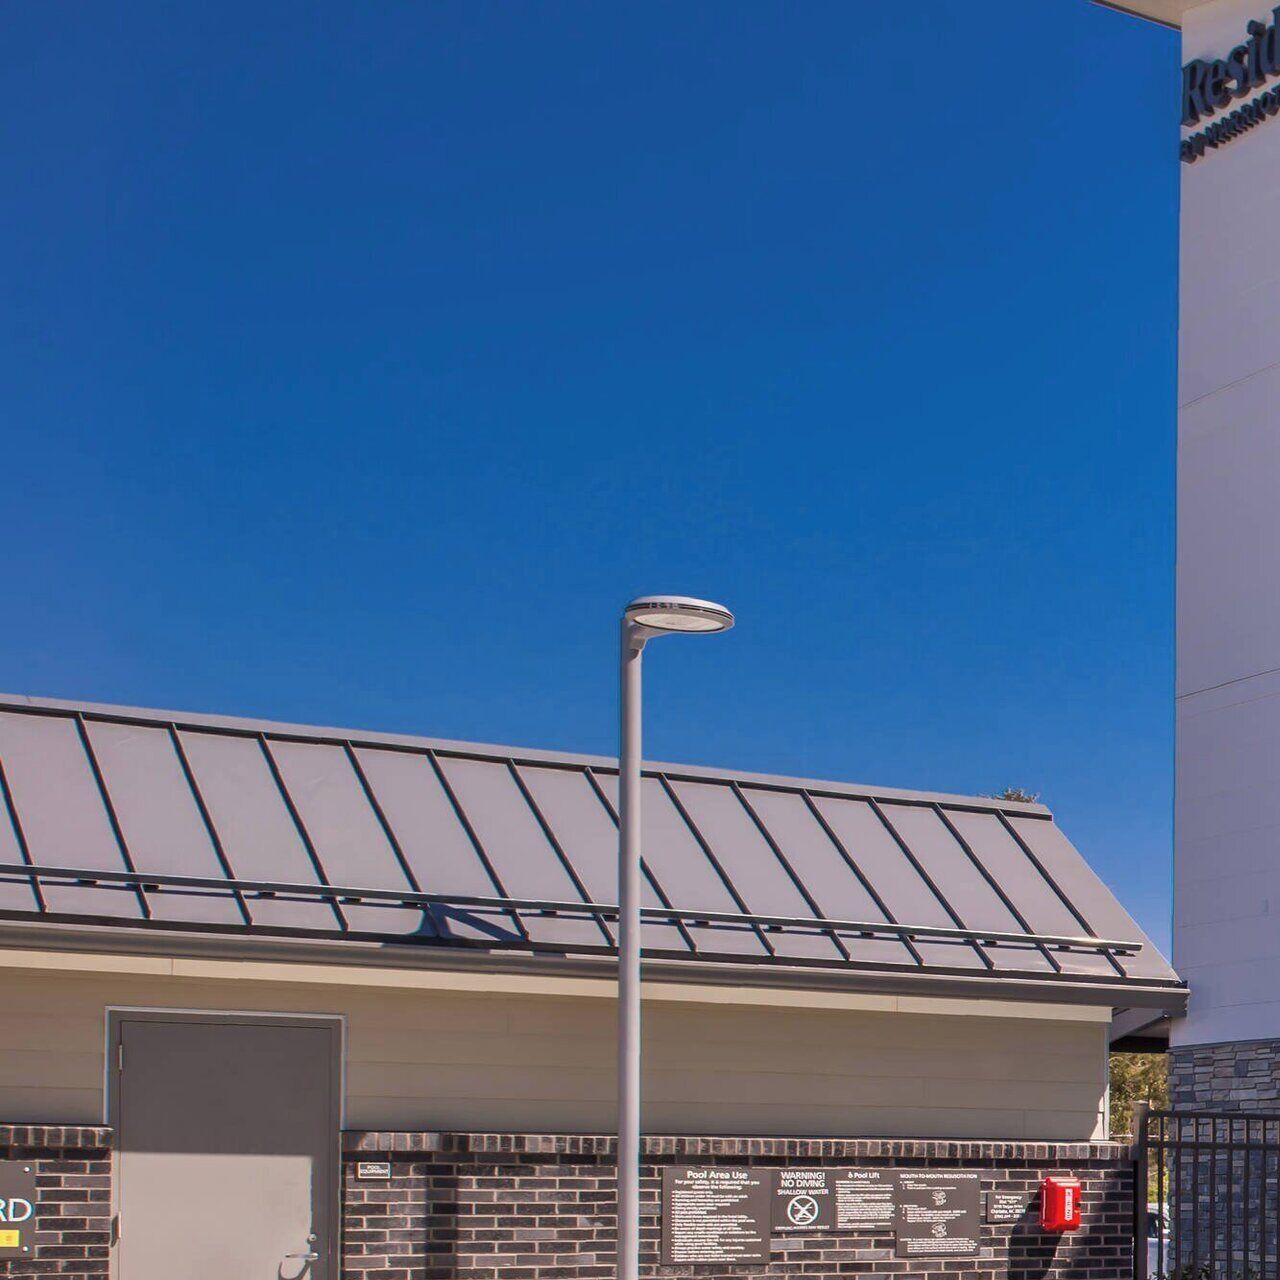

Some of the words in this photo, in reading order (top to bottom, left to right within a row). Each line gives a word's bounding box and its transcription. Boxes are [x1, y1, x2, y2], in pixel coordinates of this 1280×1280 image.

[687, 1171, 707, 1179] Pool
[709, 1171, 731, 1179] Area
[732, 1171, 749, 1179] Use
[780, 1171, 826, 1180] WARNING!
[781, 1180, 795, 1188] NO
[796, 1180, 826, 1188] DIVING
